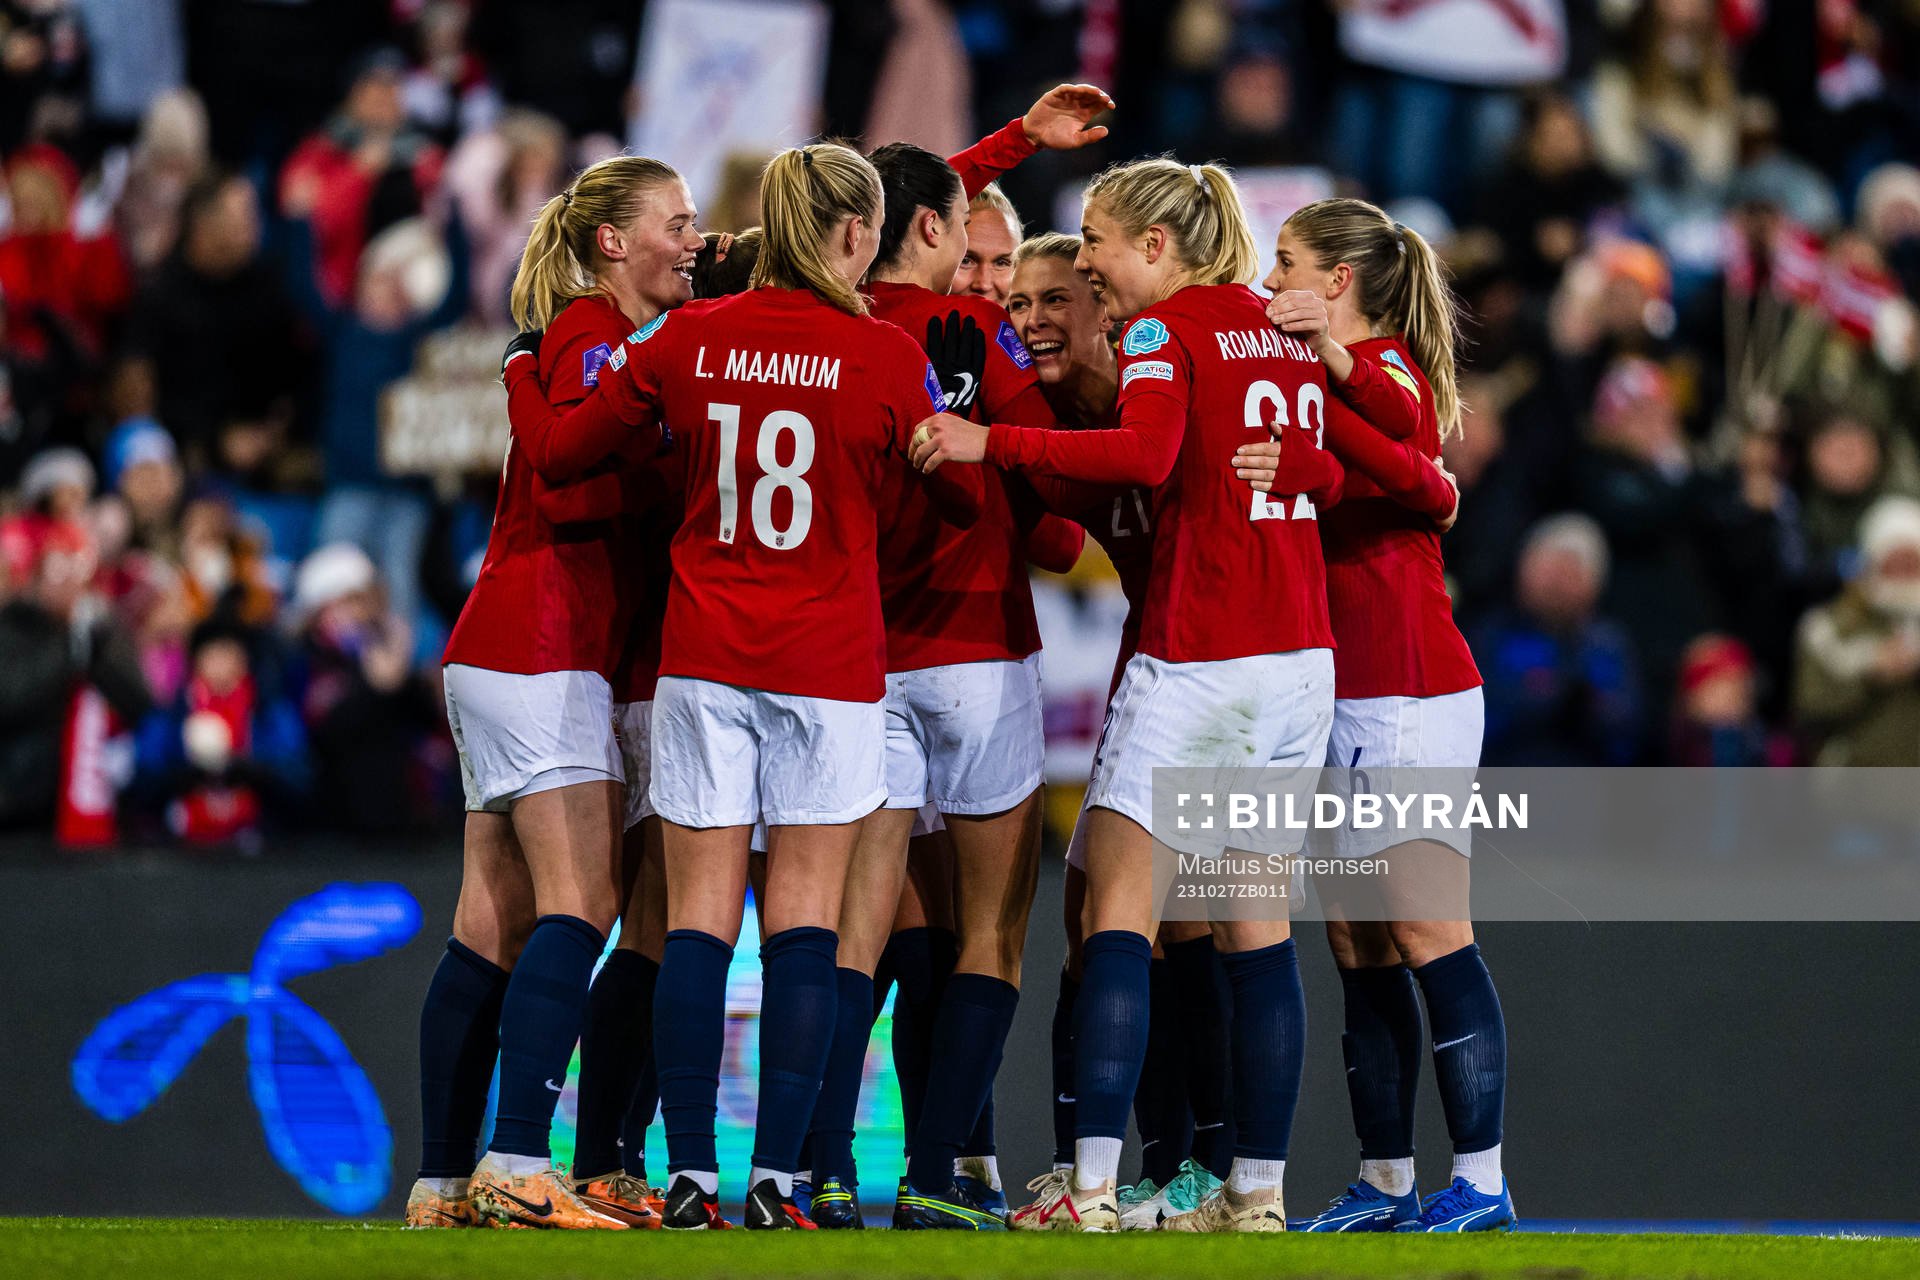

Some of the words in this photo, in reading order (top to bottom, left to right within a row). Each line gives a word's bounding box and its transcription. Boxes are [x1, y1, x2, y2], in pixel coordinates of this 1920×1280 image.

[1215, 328, 1284, 360] ROMAN
[1280, 335, 1319, 363] HAU
[695, 346, 714, 379] L.
[724, 348, 841, 390] MAANUM
[1244, 380, 1325, 521] 22
[707, 402, 816, 551] 18
[823, 1182, 841, 1190] KING
